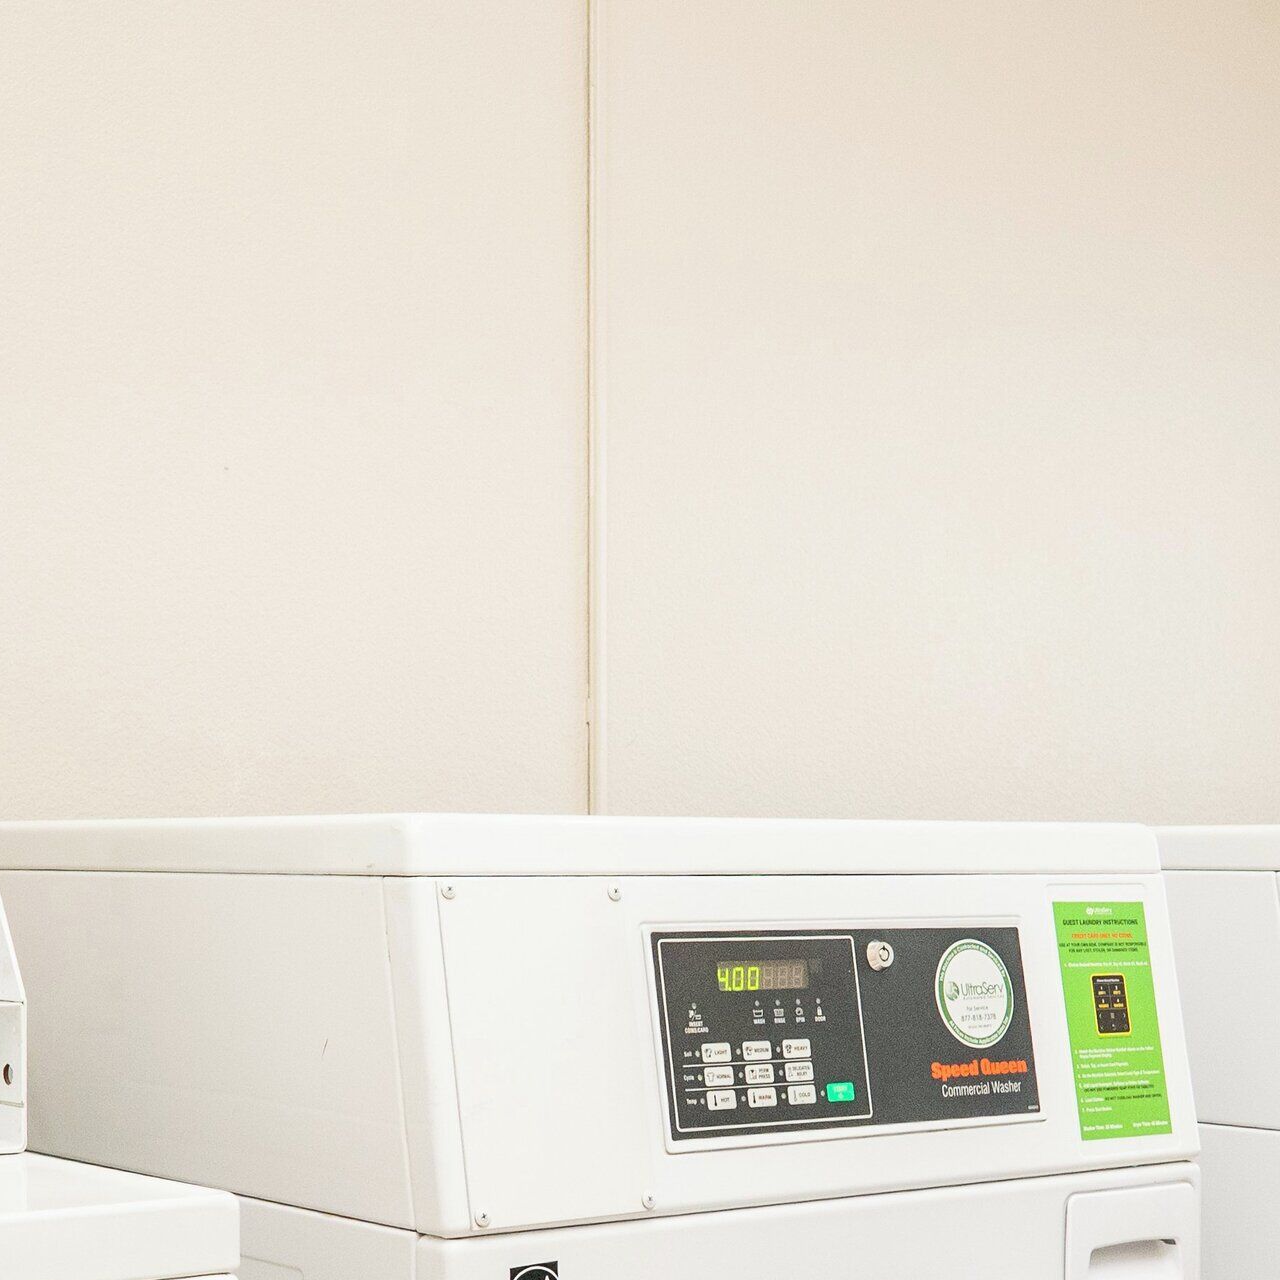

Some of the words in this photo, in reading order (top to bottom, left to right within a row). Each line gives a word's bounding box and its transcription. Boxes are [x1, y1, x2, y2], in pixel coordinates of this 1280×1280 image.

[717, 966, 760, 991] 4.00
[961, 982, 1003, 996] UltraServ
[931, 1060, 979, 1082] Speed
[980, 1058, 1027, 1075] Queen
[942, 1082, 990, 1098] Commercial
[991, 1081, 1021, 1093] Washer
